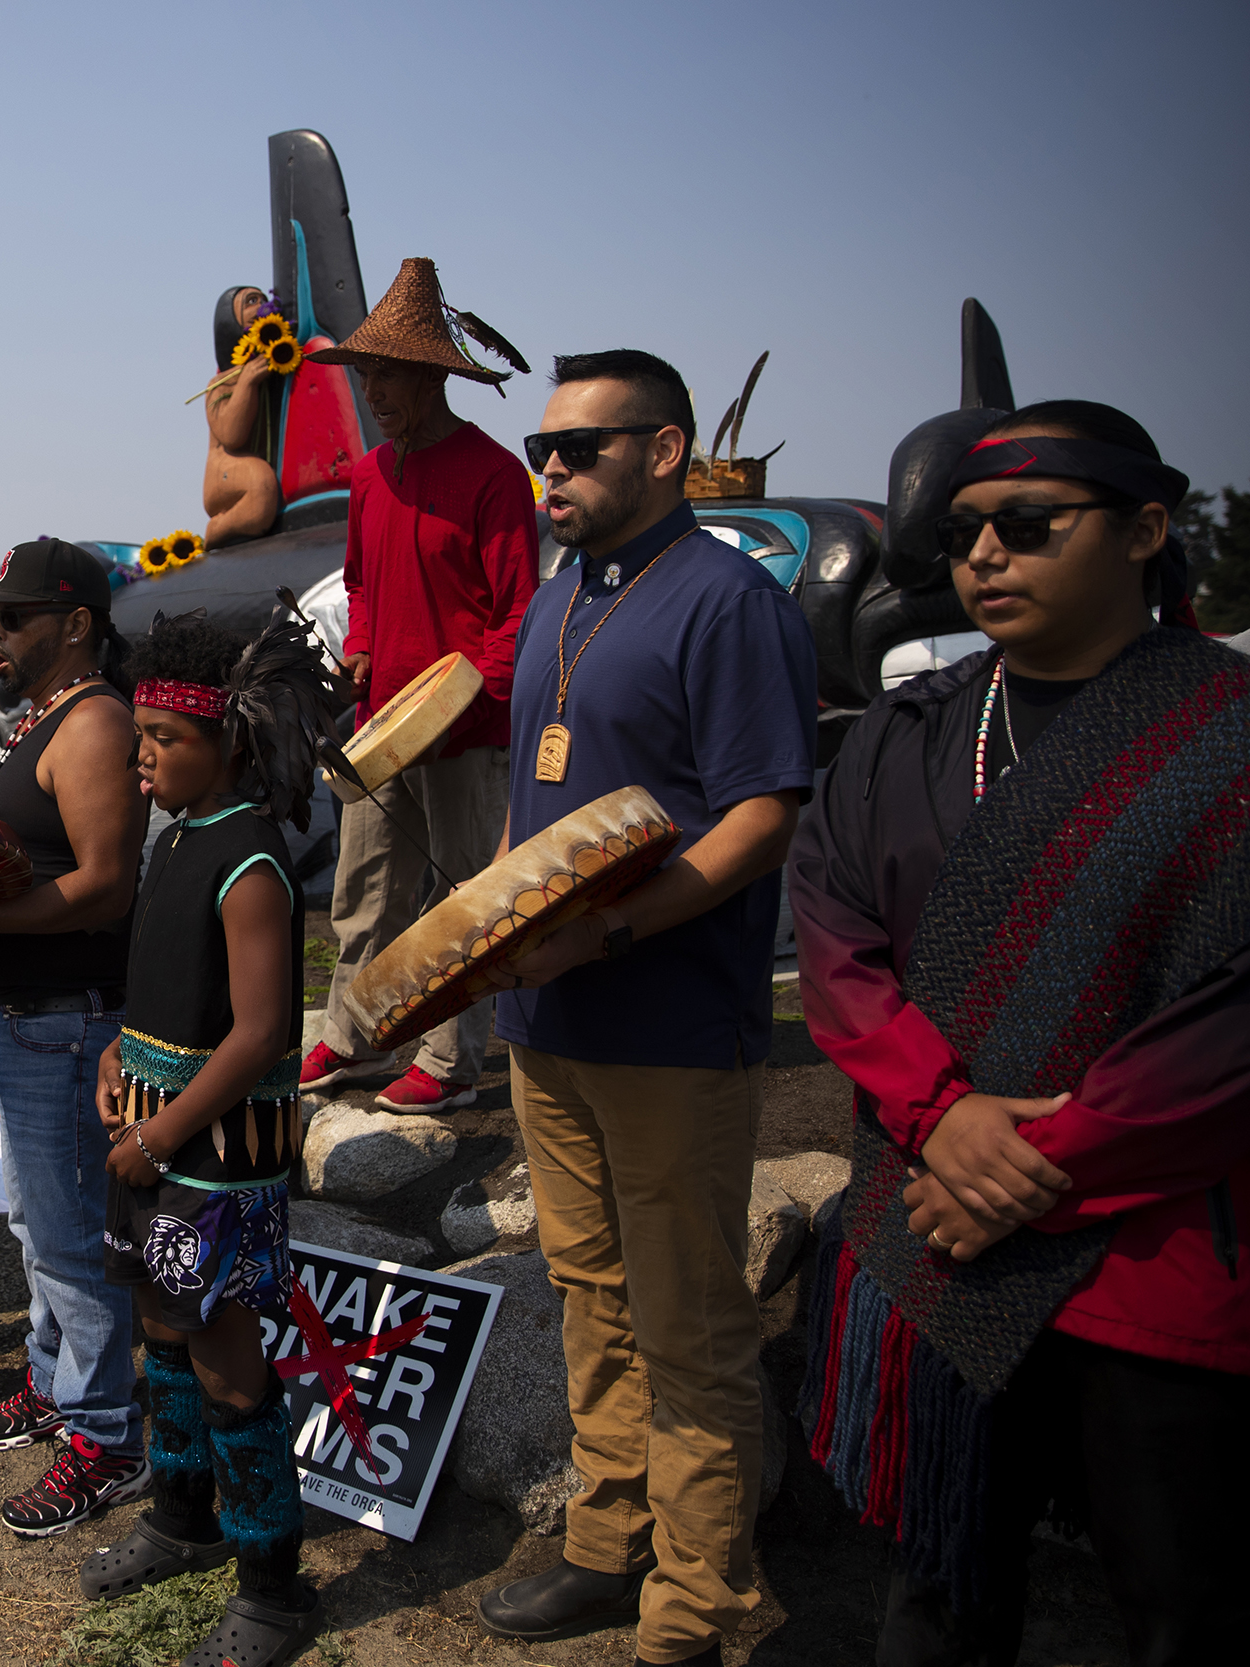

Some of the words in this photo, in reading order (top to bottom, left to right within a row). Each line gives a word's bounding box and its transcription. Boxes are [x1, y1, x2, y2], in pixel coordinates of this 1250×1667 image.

[288, 1260, 460, 1353] NAKE
[284, 1392, 410, 1486] MS
[298, 1472, 324, 1493] AVE
[326, 1483, 350, 1502] THE
[351, 1493, 386, 1517] ORCA.
